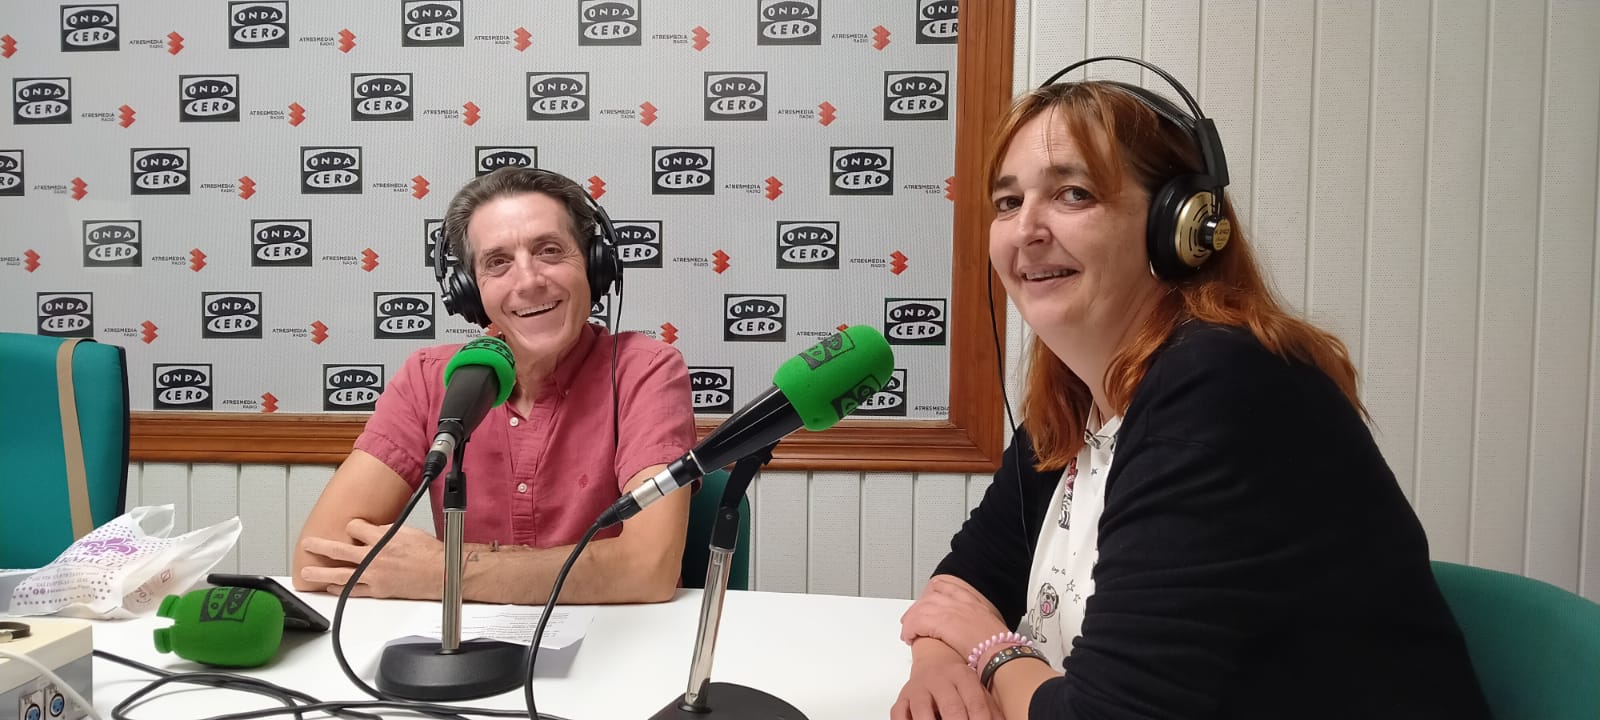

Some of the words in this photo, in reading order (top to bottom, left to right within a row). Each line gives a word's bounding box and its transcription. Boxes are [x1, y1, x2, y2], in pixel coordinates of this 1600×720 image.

[412, 10, 452, 19] ONDA
[589, 8, 630, 18] ONDA
[768, 7, 809, 16] ONDA
[928, 6, 958, 14] OND
[71, 16, 108, 24] ONDA
[239, 12, 278, 20] ONDA
[415, 26, 452, 37] CERO
[592, 26, 630, 35] CERO
[771, 24, 809, 34] CERO
[930, 23, 958, 33] CER
[73, 32, 109, 42] CERO
[242, 28, 278, 38] CERO
[190, 86, 228, 94] ONDA
[362, 84, 401, 93] ONDA
[538, 83, 578, 92] ONDA
[715, 83, 756, 92] ONDA
[895, 83, 936, 91] ONDA
[23, 88, 61, 97] ONDA
[26, 104, 61, 114] CERO
[192, 102, 228, 112] CERO
[364, 101, 402, 110] CERO
[540, 100, 578, 110] CERO
[718, 100, 756, 110] CERO
[898, 100, 937, 110] CERO
[141, 158, 179, 167] ONDA
[311, 158, 351, 166] ONDA
[486, 157, 526, 166] ONDA
[663, 158, 703, 166] ONDA
[841, 158, 882, 167] ONDA
[143, 175, 179, 185] CERO
[314, 174, 351, 184] CERO
[665, 174, 703, 184] CERO
[843, 175, 882, 185] CERO
[93, 231, 131, 240] ONDA
[262, 230, 300, 239] ONDA
[788, 232, 828, 241] ONDA
[96, 247, 131, 257] CERO
[264, 247, 301, 256] CERO
[623, 248, 651, 258] ERO
[790, 249, 828, 258] CERO
[46, 302, 83, 311] ONDA
[212, 302, 250, 311] ONDA
[384, 303, 424, 311] ONDA
[735, 305, 774, 313] ONDA
[894, 309, 935, 318] ONDA
[48, 318, 84, 328] CERO
[214, 319, 251, 329] CERO
[387, 319, 424, 329] CERO
[737, 322, 774, 331] CERO
[896, 326, 935, 335] CERO
[163, 374, 201, 382] ONDA
[334, 375, 373, 383] ONDA
[166, 390, 202, 400] CERO
[336, 391, 373, 401] CERO
[694, 394, 722, 403] ERO
[866, 396, 895, 406] ERO
